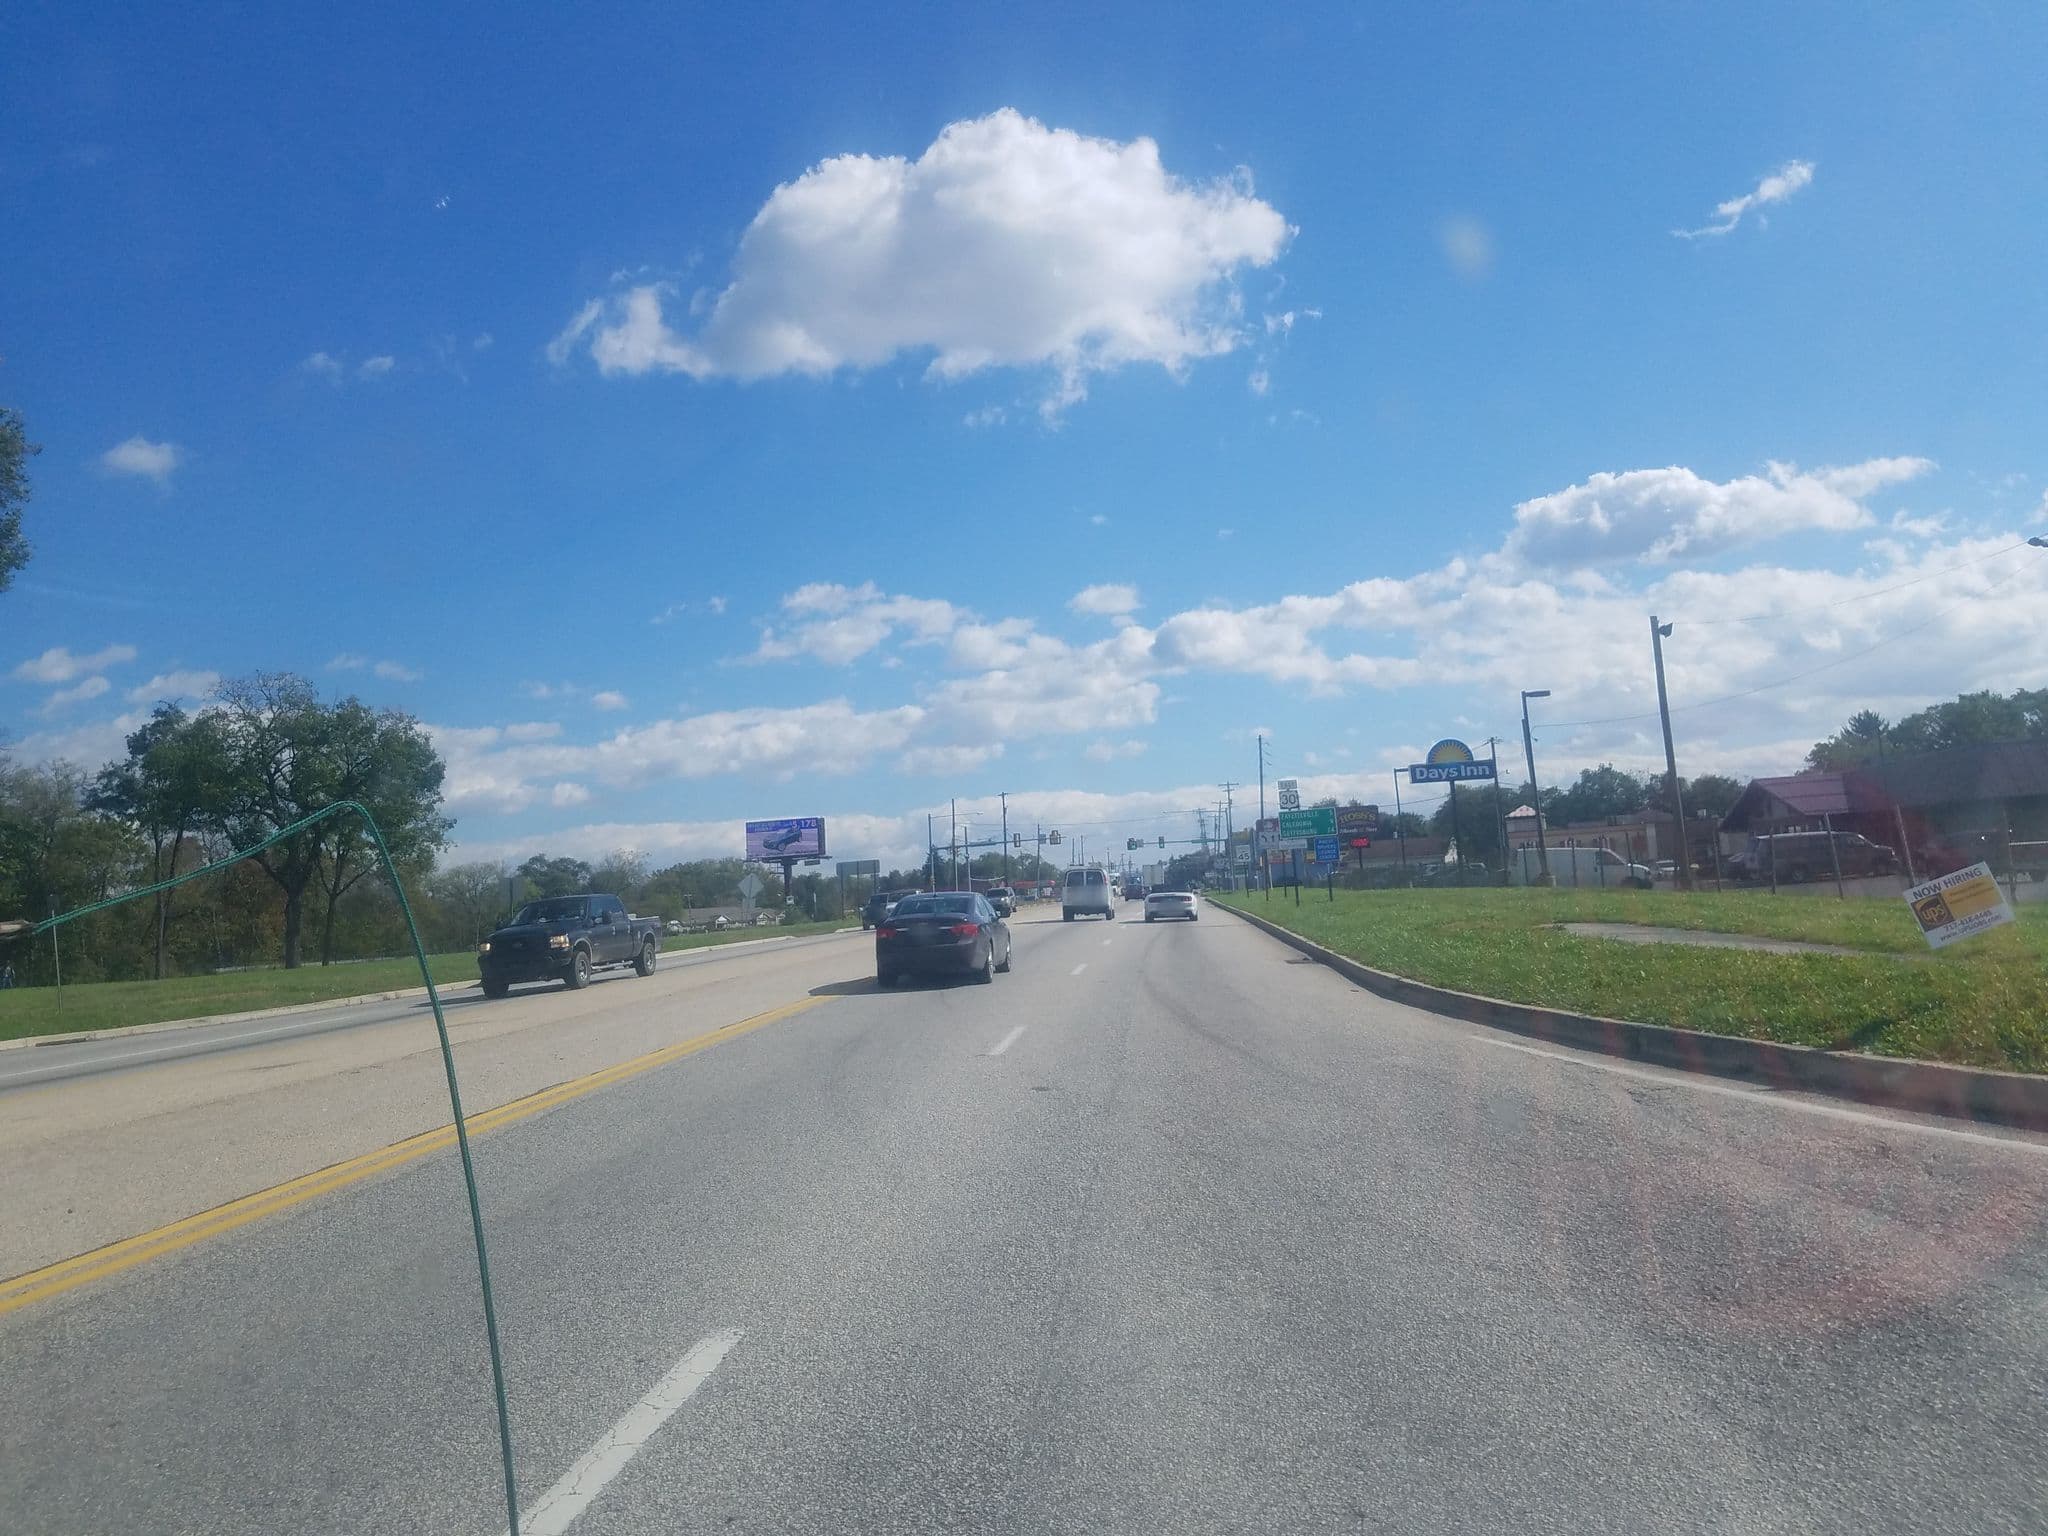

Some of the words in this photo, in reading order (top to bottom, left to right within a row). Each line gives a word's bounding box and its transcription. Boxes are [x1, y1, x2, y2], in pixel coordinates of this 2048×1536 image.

[1415, 767, 1457, 780] Days
[1460, 765, 1489, 777] Inn
[1281, 794, 1296, 805] 30
[1238, 852, 1250, 860] 45
[1912, 882, 1942, 899] NOW
[1943, 867, 1983, 888] HIRING
[1922, 904, 1944, 921] ups
